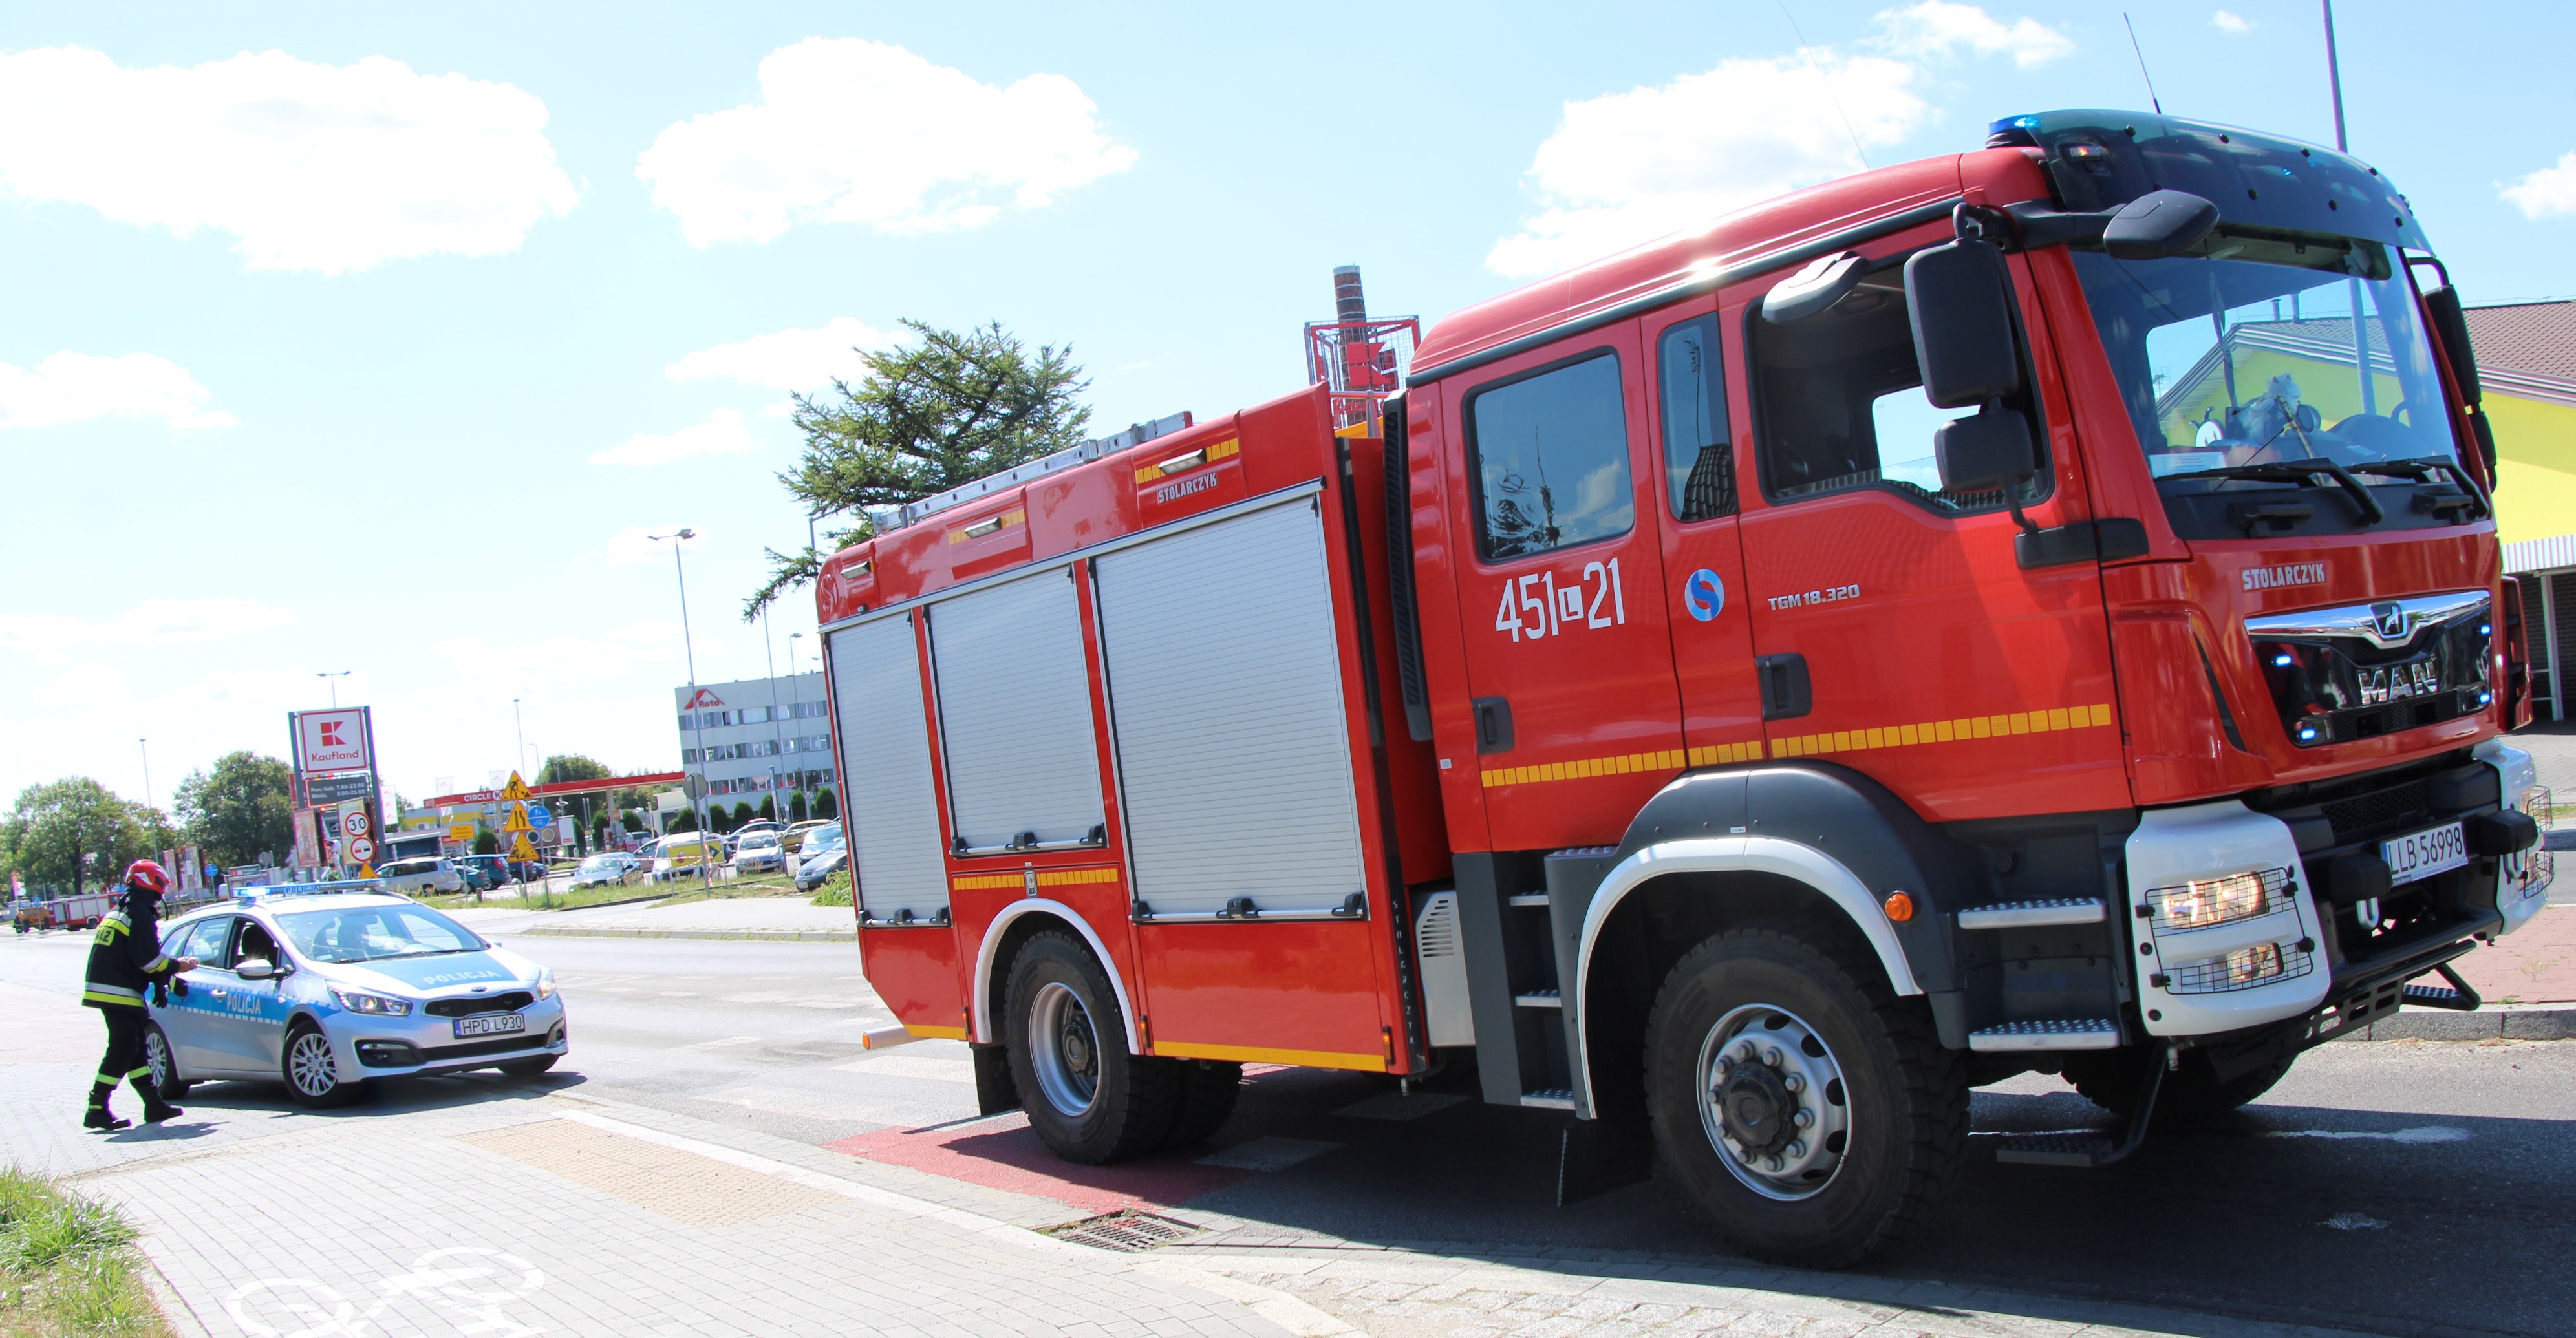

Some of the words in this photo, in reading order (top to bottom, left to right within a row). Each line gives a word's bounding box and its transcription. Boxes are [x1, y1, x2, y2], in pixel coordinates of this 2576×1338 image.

[1157, 472, 1217, 504] STOLARCZYK
[2242, 563, 2325, 590] STOLARCZYK
[1768, 593, 1801, 611] TGM
[1803, 584, 1860, 606] 18.320
[2358, 661, 2437, 705] MAN
[698, 700, 720, 708] Roto
[311, 749, 359, 762] Kaufland
[464, 792, 491, 802] CIRCLE
[349, 818, 367, 831] 30
[2388, 839, 2417, 875] LLB
[2420, 826, 2462, 865] 56998
[422, 970, 502, 984] POLICJA
[1392, 900, 1415, 1045] STOLARCZYK
[227, 994, 261, 1015] POLICJA
[462, 1019, 490, 1034] HPD
[494, 1015, 522, 1030] L930
